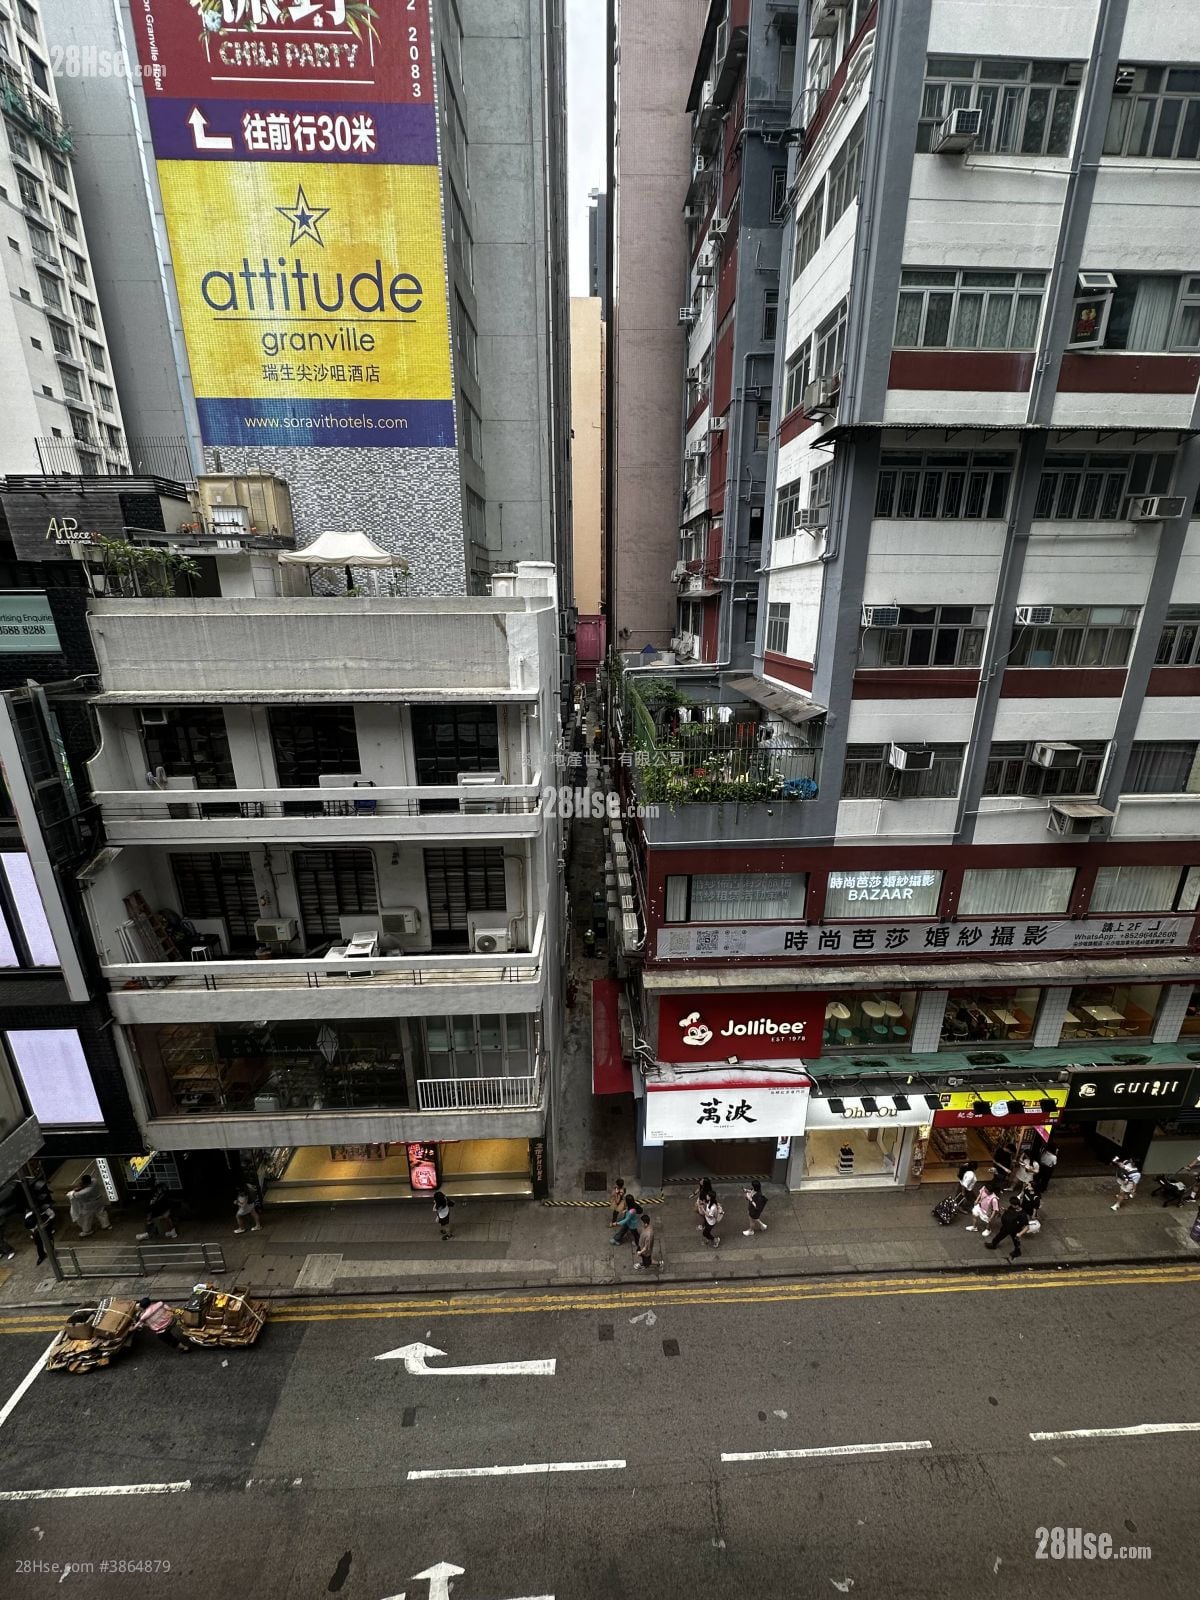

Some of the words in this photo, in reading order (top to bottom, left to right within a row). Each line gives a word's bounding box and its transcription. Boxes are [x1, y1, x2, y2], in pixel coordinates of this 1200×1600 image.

[145, 14, 159, 62] Granville
[152, 63, 164, 91] Hotel
[219, 41, 279, 68] CHILI
[285, 42, 359, 68] PARTY
[408, 26, 422, 97] 2083
[242, 112, 376, 152] 往前行30米
[201, 256, 423, 313] attitude
[261, 326, 376, 357] granville
[262, 363, 381, 383] 瑞生尖沙咀酒店
[243, 413, 409, 430] www.soravithotels.com
[22, 625, 46, 635] 8288
[847, 888, 914, 901] BAZAAR
[783, 924, 1050, 951] 時尚芭莎婚紗攝影
[1127, 921, 1143, 931] 2F
[720, 1018, 805, 1037] Jollibee
[696, 1097, 758, 1125] 萬波
[97, 1159, 109, 1179] HONG
[104, 1180, 116, 1200] KONG
